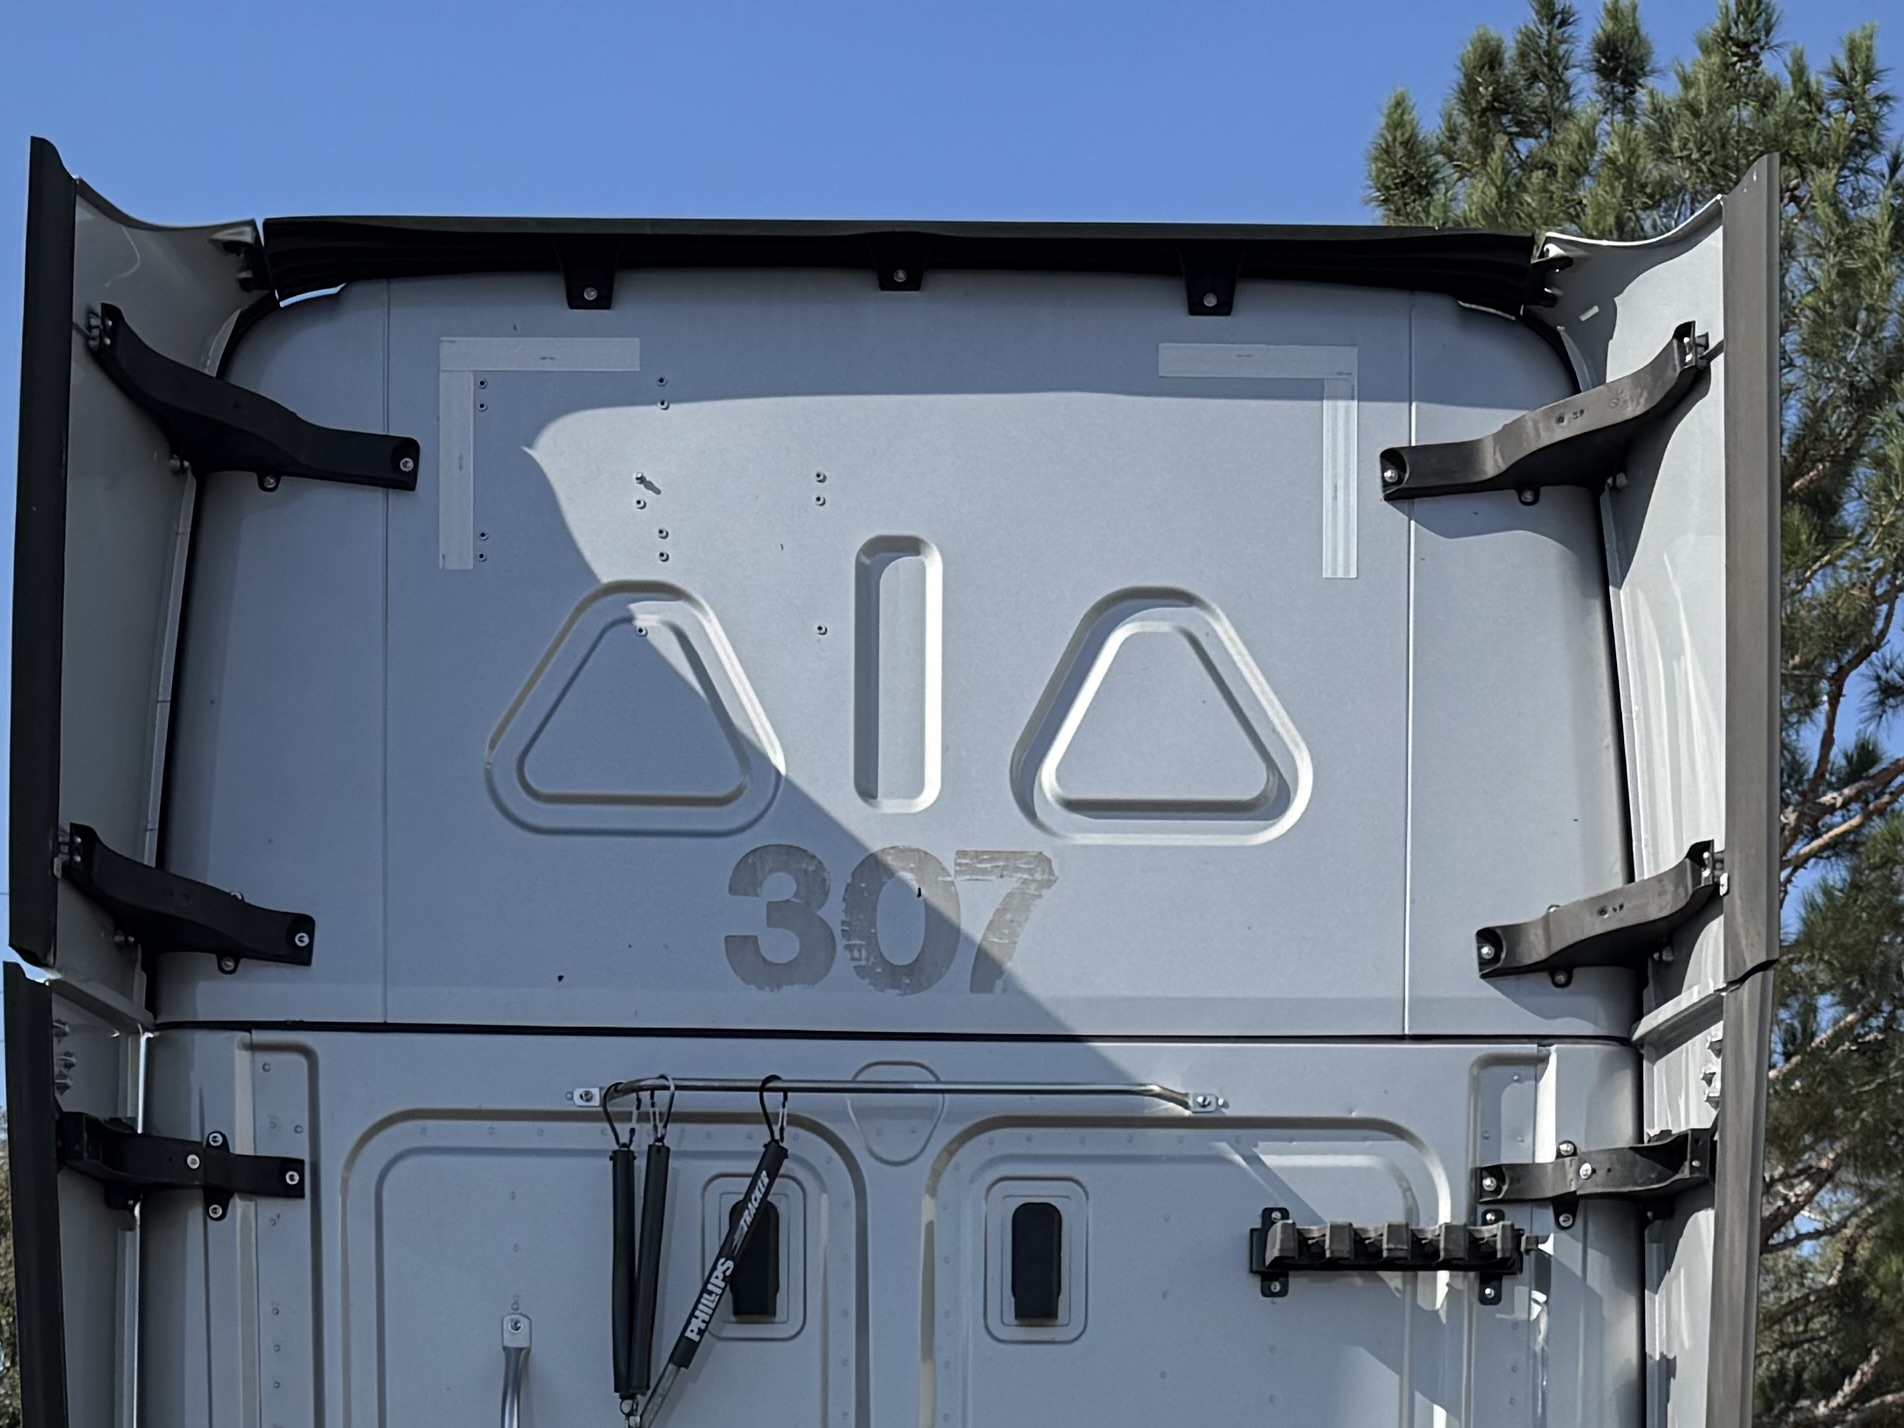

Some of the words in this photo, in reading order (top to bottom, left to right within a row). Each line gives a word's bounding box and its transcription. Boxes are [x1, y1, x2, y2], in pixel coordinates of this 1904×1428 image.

[724, 844, 1057, 995] 307
[684, 1257, 734, 1342] PHILLIPS
[741, 1170, 770, 1232] TRACKER
